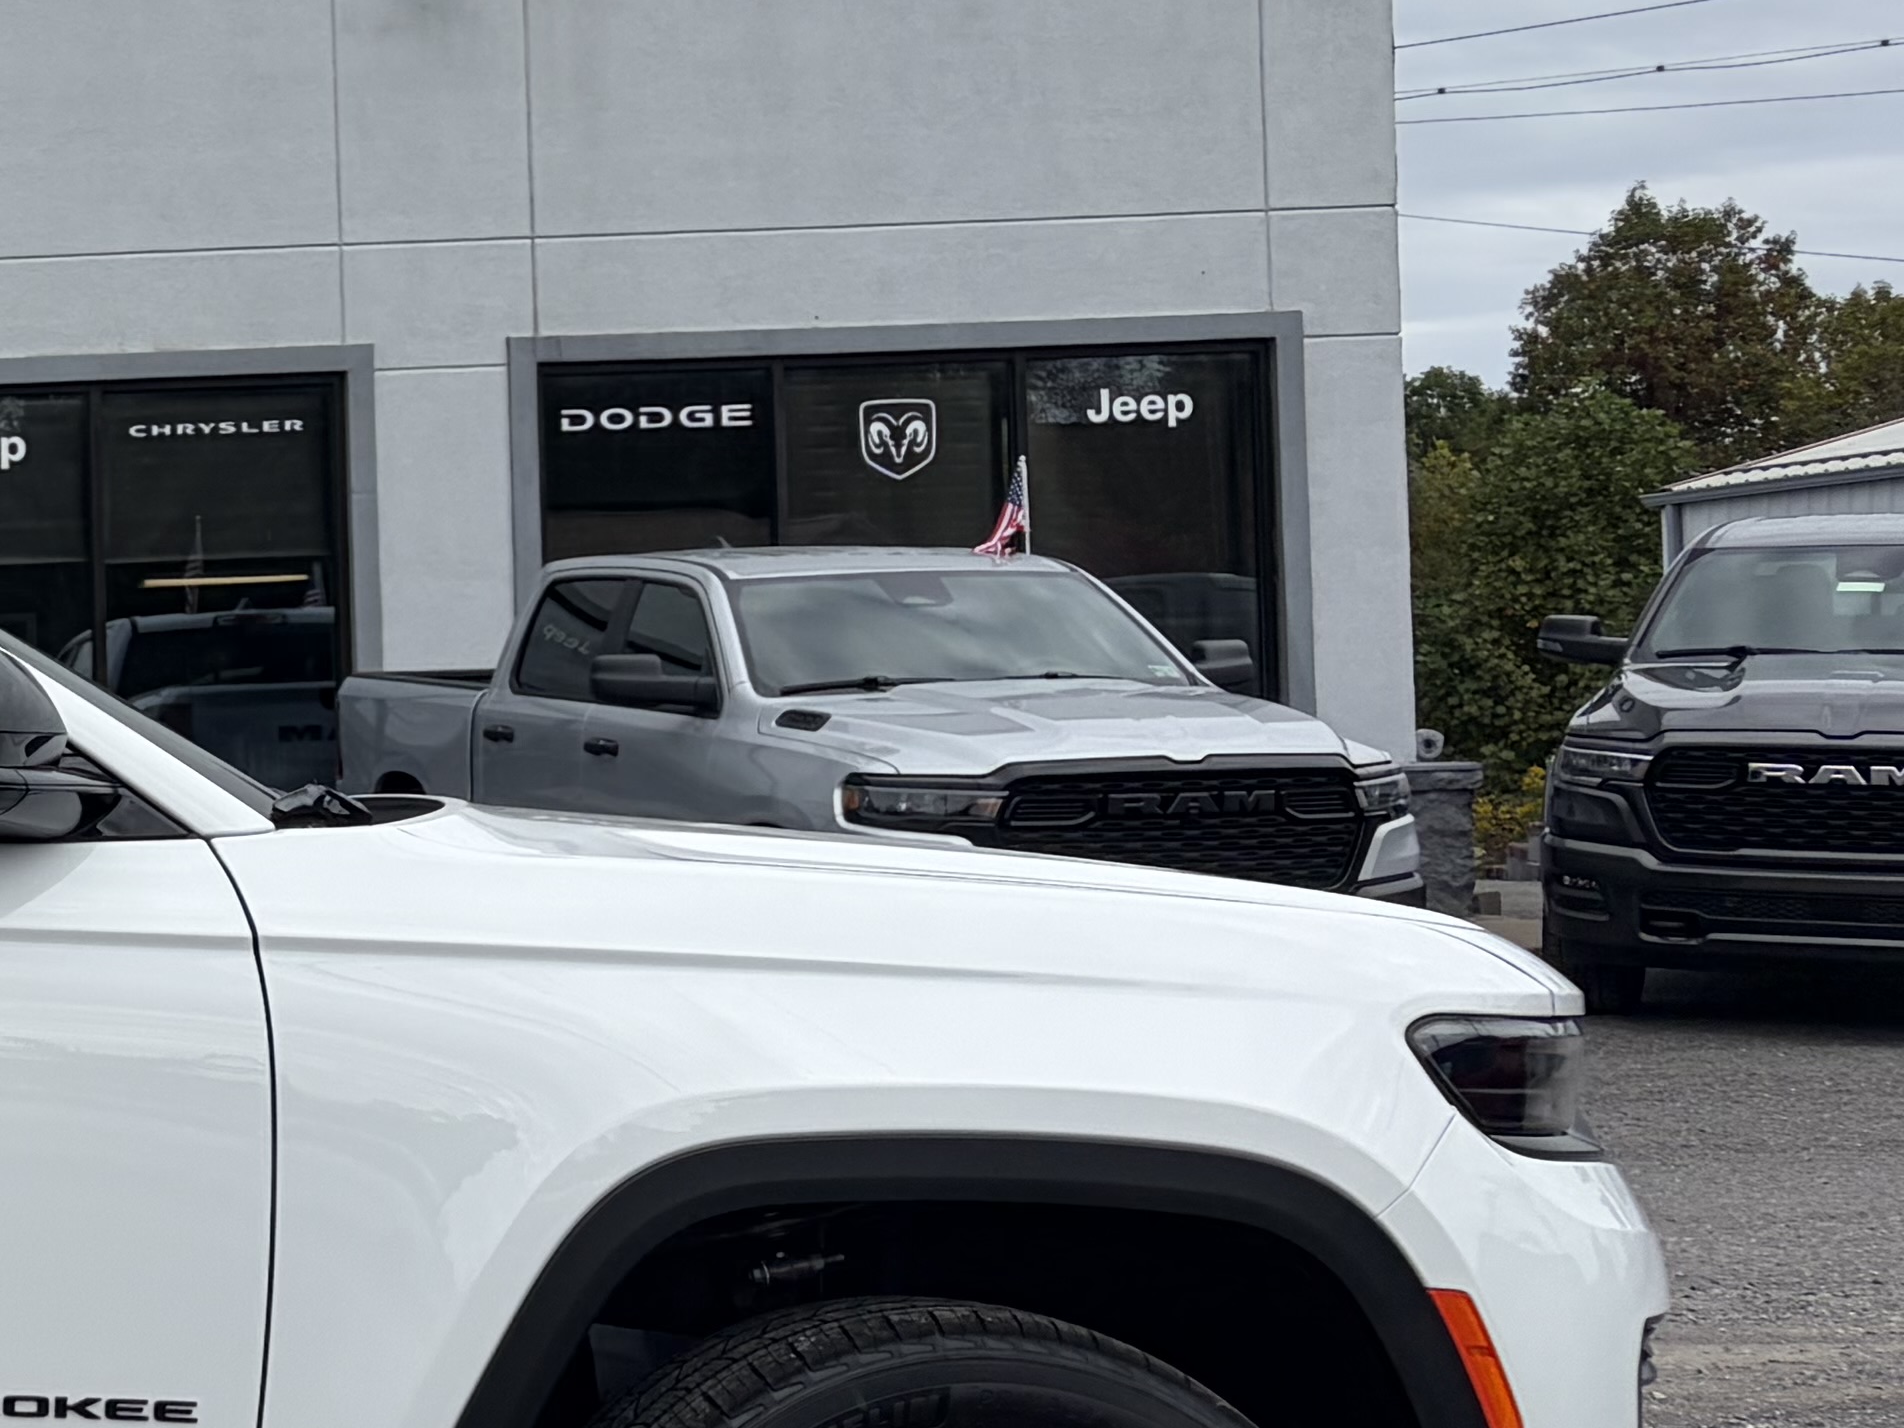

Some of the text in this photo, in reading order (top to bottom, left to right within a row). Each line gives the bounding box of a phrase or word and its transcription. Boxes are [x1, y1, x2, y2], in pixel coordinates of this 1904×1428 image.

[560, 402, 755, 433] DODGE
[1086, 388, 1194, 429] Jeep
[129, 418, 306, 439] CHRYSLER
[1747, 762, 1904, 786] RAM
[1107, 790, 1276, 814] RAM
